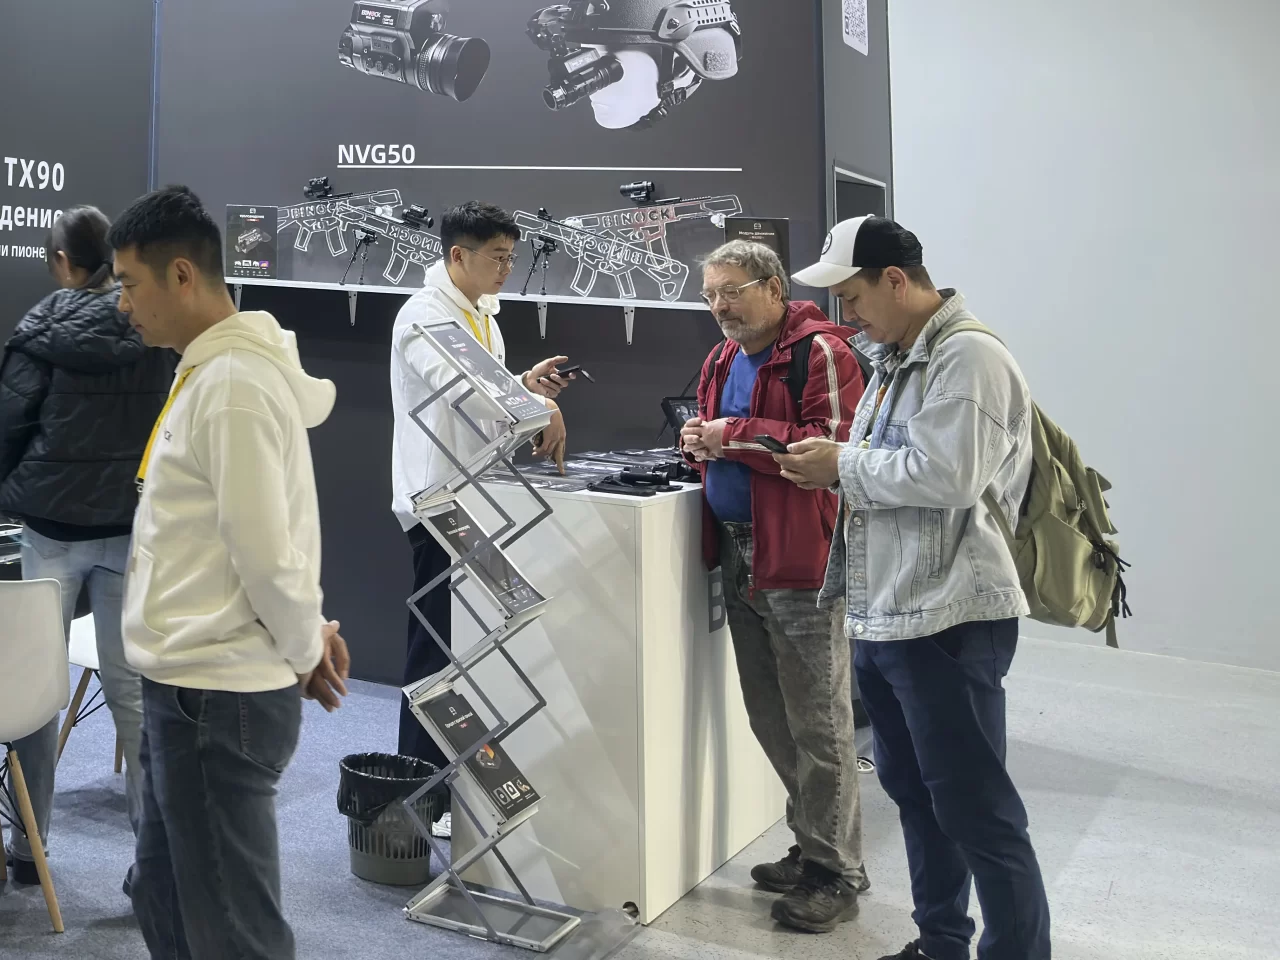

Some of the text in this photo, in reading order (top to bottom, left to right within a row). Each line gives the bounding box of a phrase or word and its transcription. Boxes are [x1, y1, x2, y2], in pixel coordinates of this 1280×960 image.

[338, 144, 416, 164] NVG50
[4, 157, 65, 191] TX90
[602, 209, 670, 228] BINOCK
[11, 244, 47, 262] пионе
